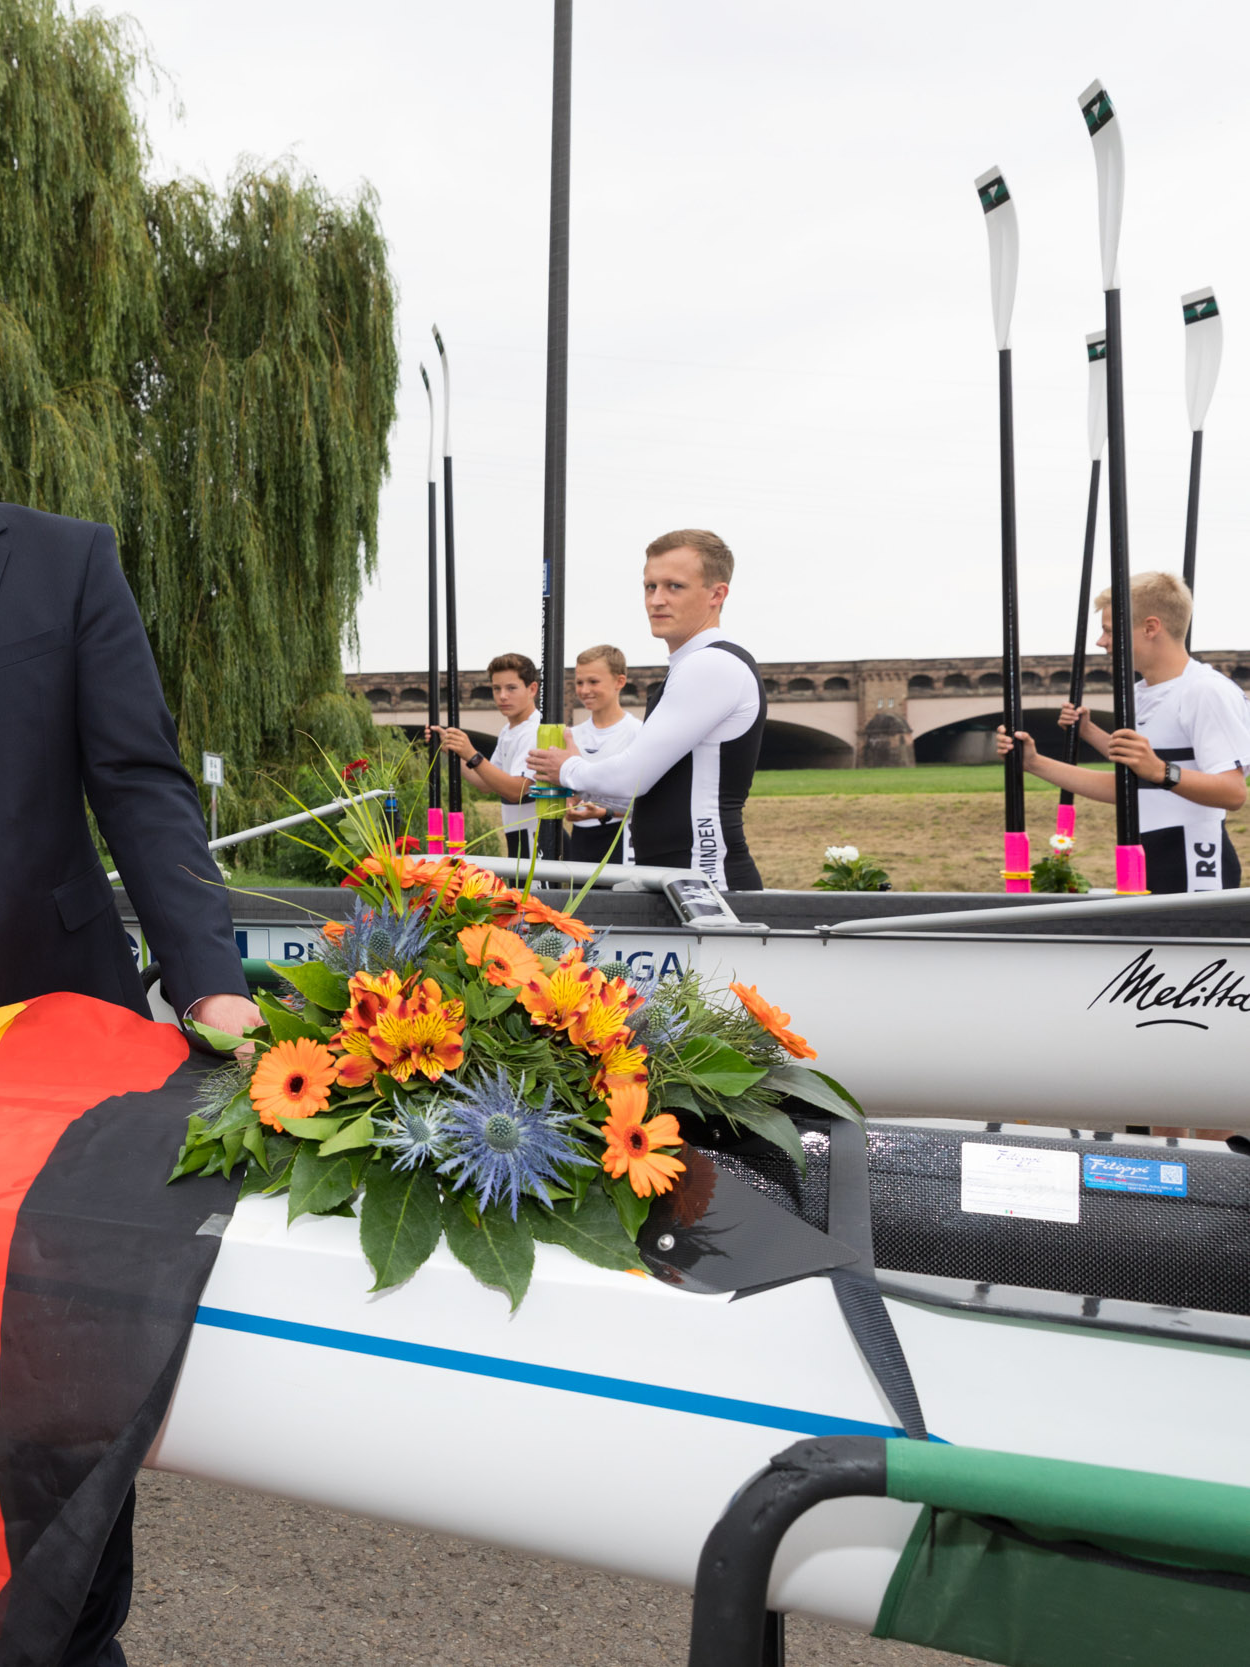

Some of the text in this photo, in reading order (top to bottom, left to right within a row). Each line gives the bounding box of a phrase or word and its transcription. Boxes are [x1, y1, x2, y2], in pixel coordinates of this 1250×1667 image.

[1193, 842, 1217, 878] RC
[1087, 948, 1250, 1012] Melitta
[1088, 1157, 1150, 1176] Filippi
